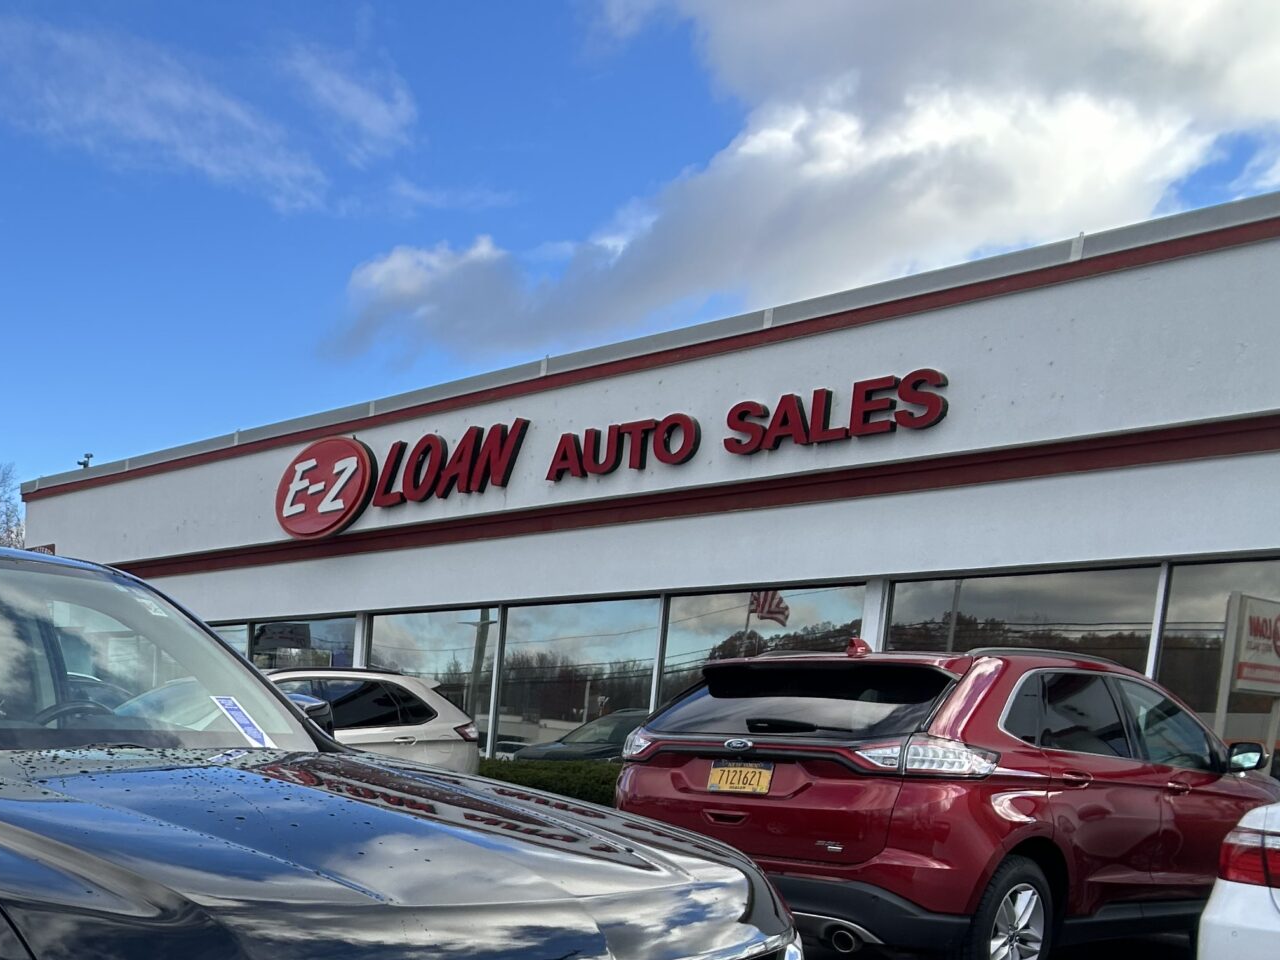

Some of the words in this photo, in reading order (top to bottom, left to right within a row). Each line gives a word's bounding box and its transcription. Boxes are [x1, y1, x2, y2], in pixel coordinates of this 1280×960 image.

[282, 456, 358, 518] E-Z
[372, 418, 530, 508] LOAN
[545, 413, 702, 482] AUTO
[723, 368, 949, 456] SALES
[718, 769, 762, 787] 7121621
